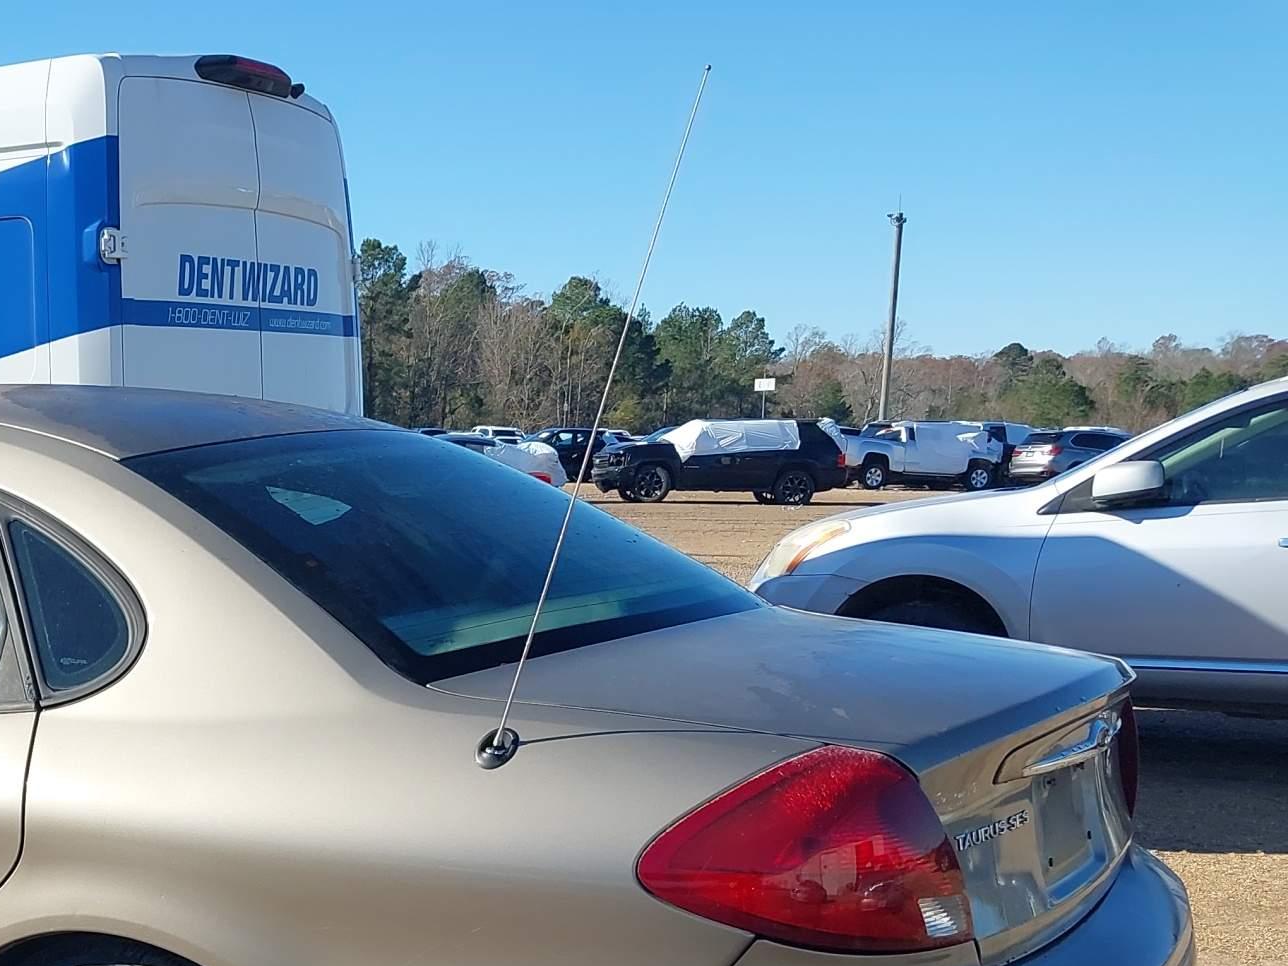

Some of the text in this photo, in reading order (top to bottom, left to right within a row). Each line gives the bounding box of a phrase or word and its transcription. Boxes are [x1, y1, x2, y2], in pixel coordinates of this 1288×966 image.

[168, 307, 251, 327] 1-800-DENT-WIZ
[953, 809, 1030, 852] TAURUS SES
